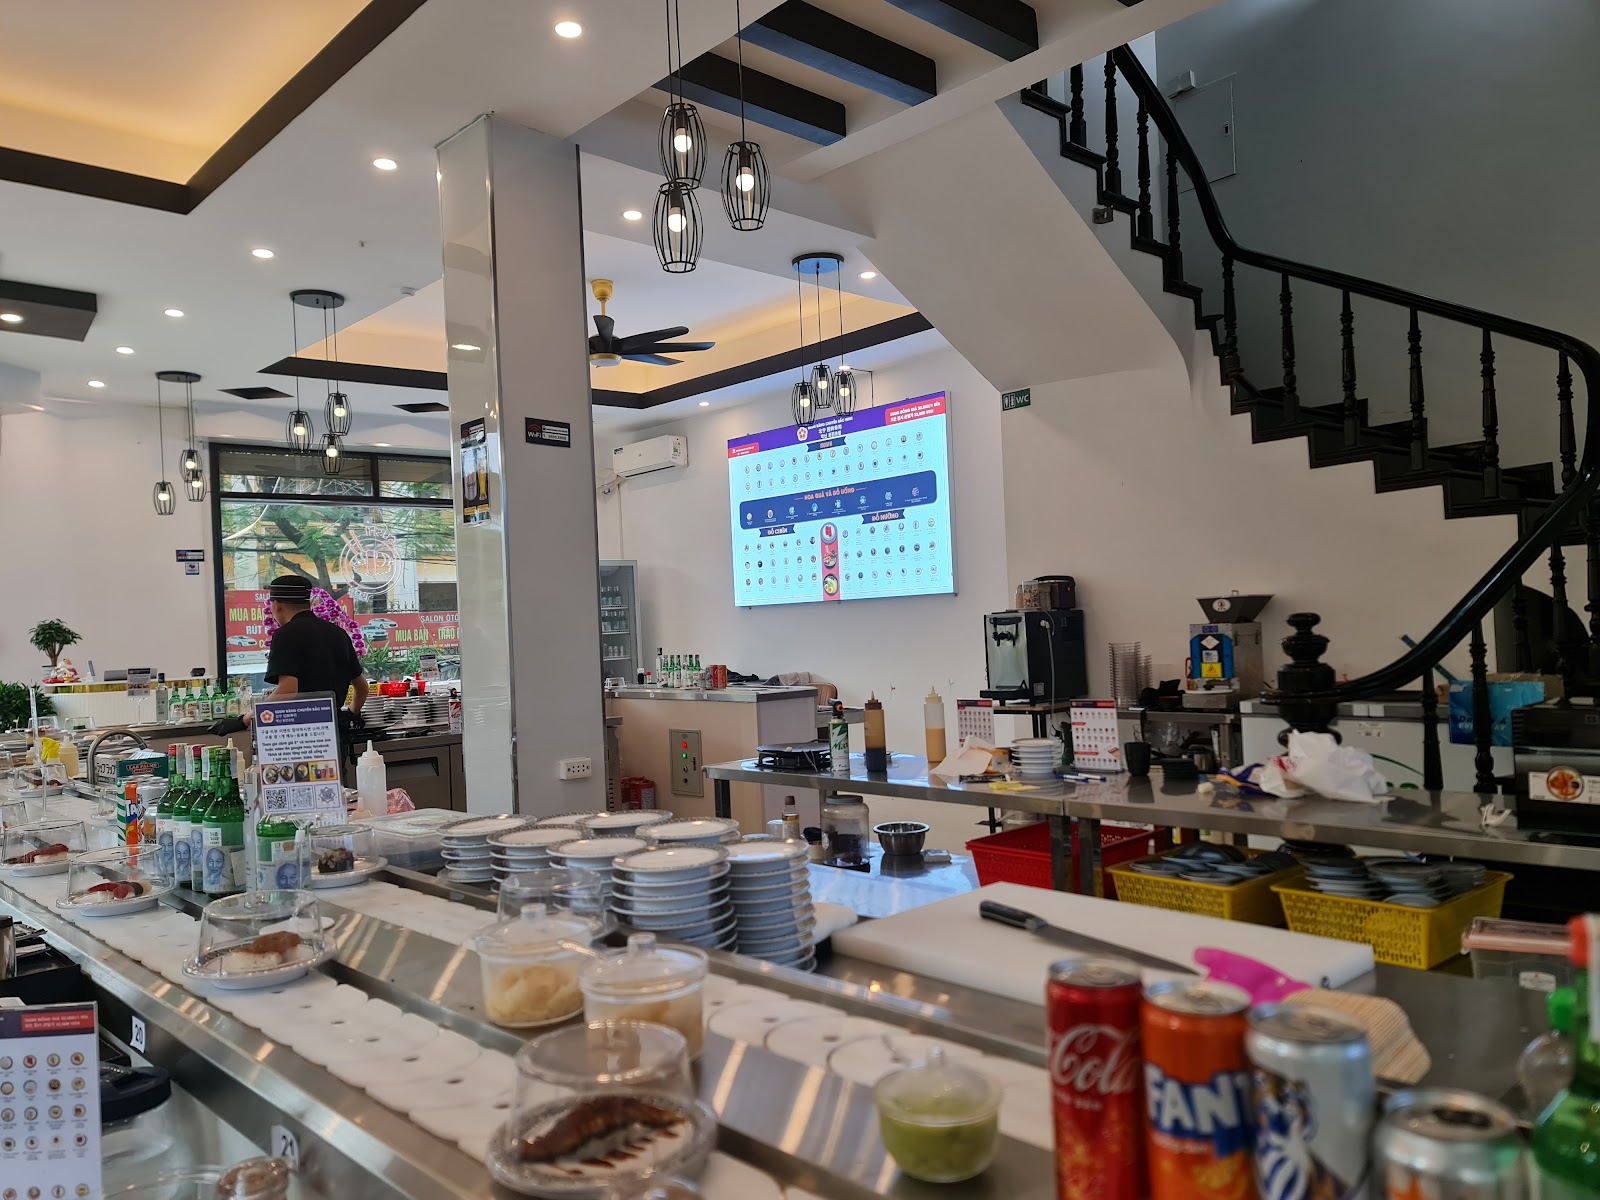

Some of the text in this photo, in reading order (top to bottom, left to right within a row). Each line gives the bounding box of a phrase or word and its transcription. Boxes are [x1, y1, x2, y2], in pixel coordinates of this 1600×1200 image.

[1016, 394, 1029, 404] WC
[229, 608, 248, 621] MUA
[246, 624, 262, 634] RÚT
[395, 629, 412, 642] MUA
[414, 626, 429, 641] BÁN
[438, 627, 455, 640] TRAO
[135, 1024, 143, 1044] 20
[282, 1135, 294, 1156] 21
